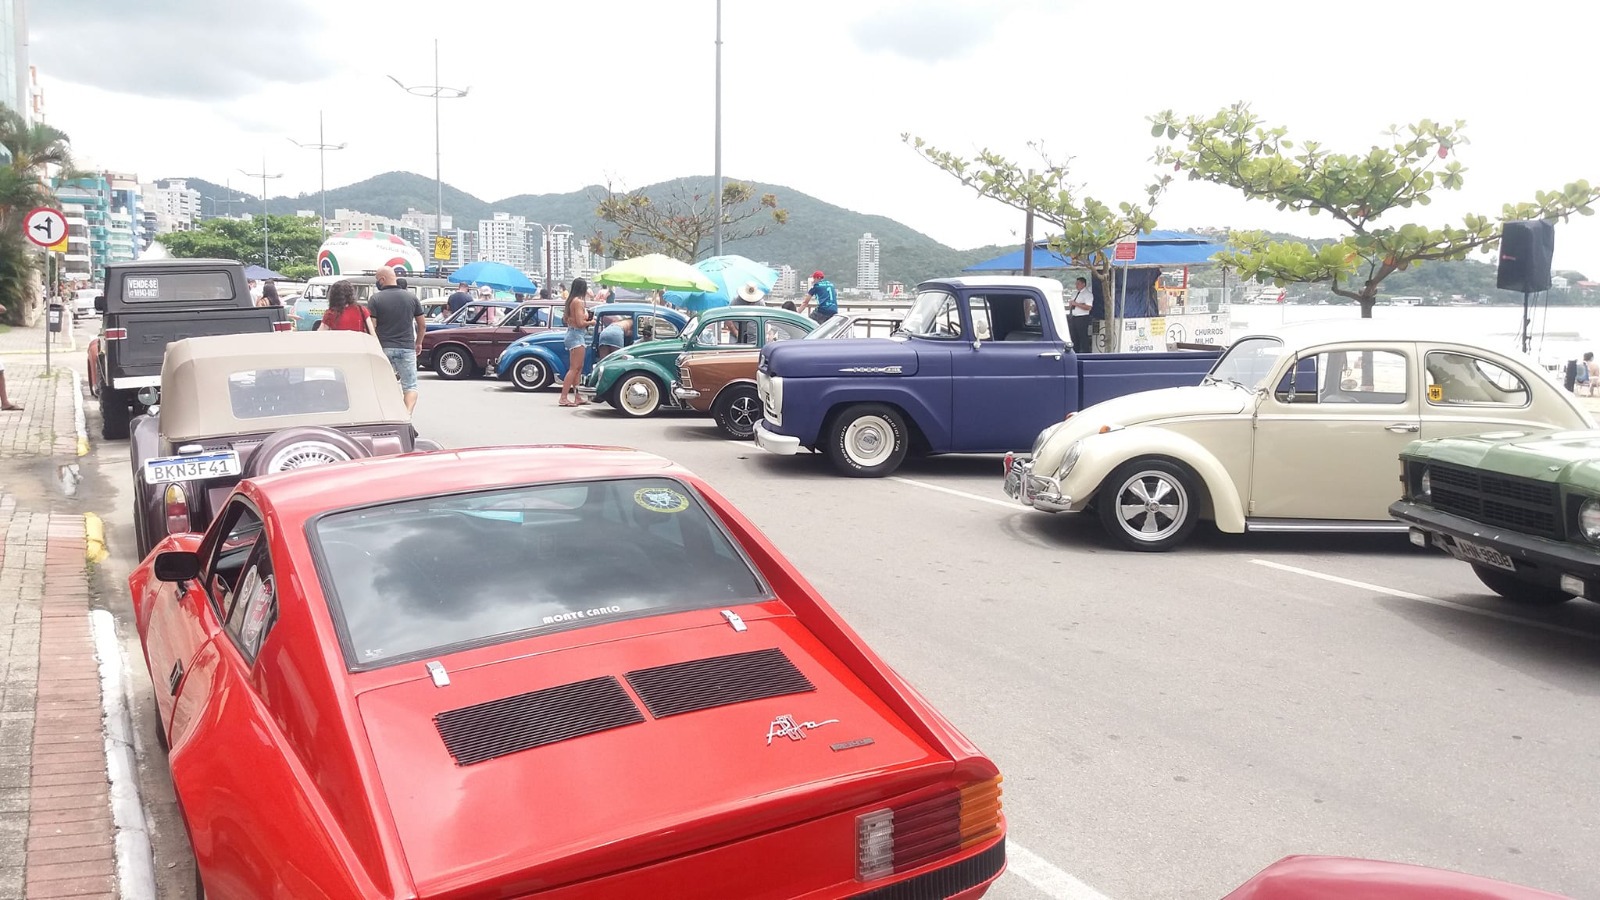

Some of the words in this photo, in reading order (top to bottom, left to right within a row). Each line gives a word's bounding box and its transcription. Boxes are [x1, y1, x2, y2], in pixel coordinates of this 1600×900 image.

[128, 279, 157, 289] VENDE-SE
[1169, 329, 1183, 344] 31
[1194, 328, 1224, 336] CHURROS
[1194, 337, 1215, 345] MILHO
[154, 460, 230, 480] BKN3F41
[542, 610, 585, 624] MONTE
[586, 605, 621, 617] CARLO
